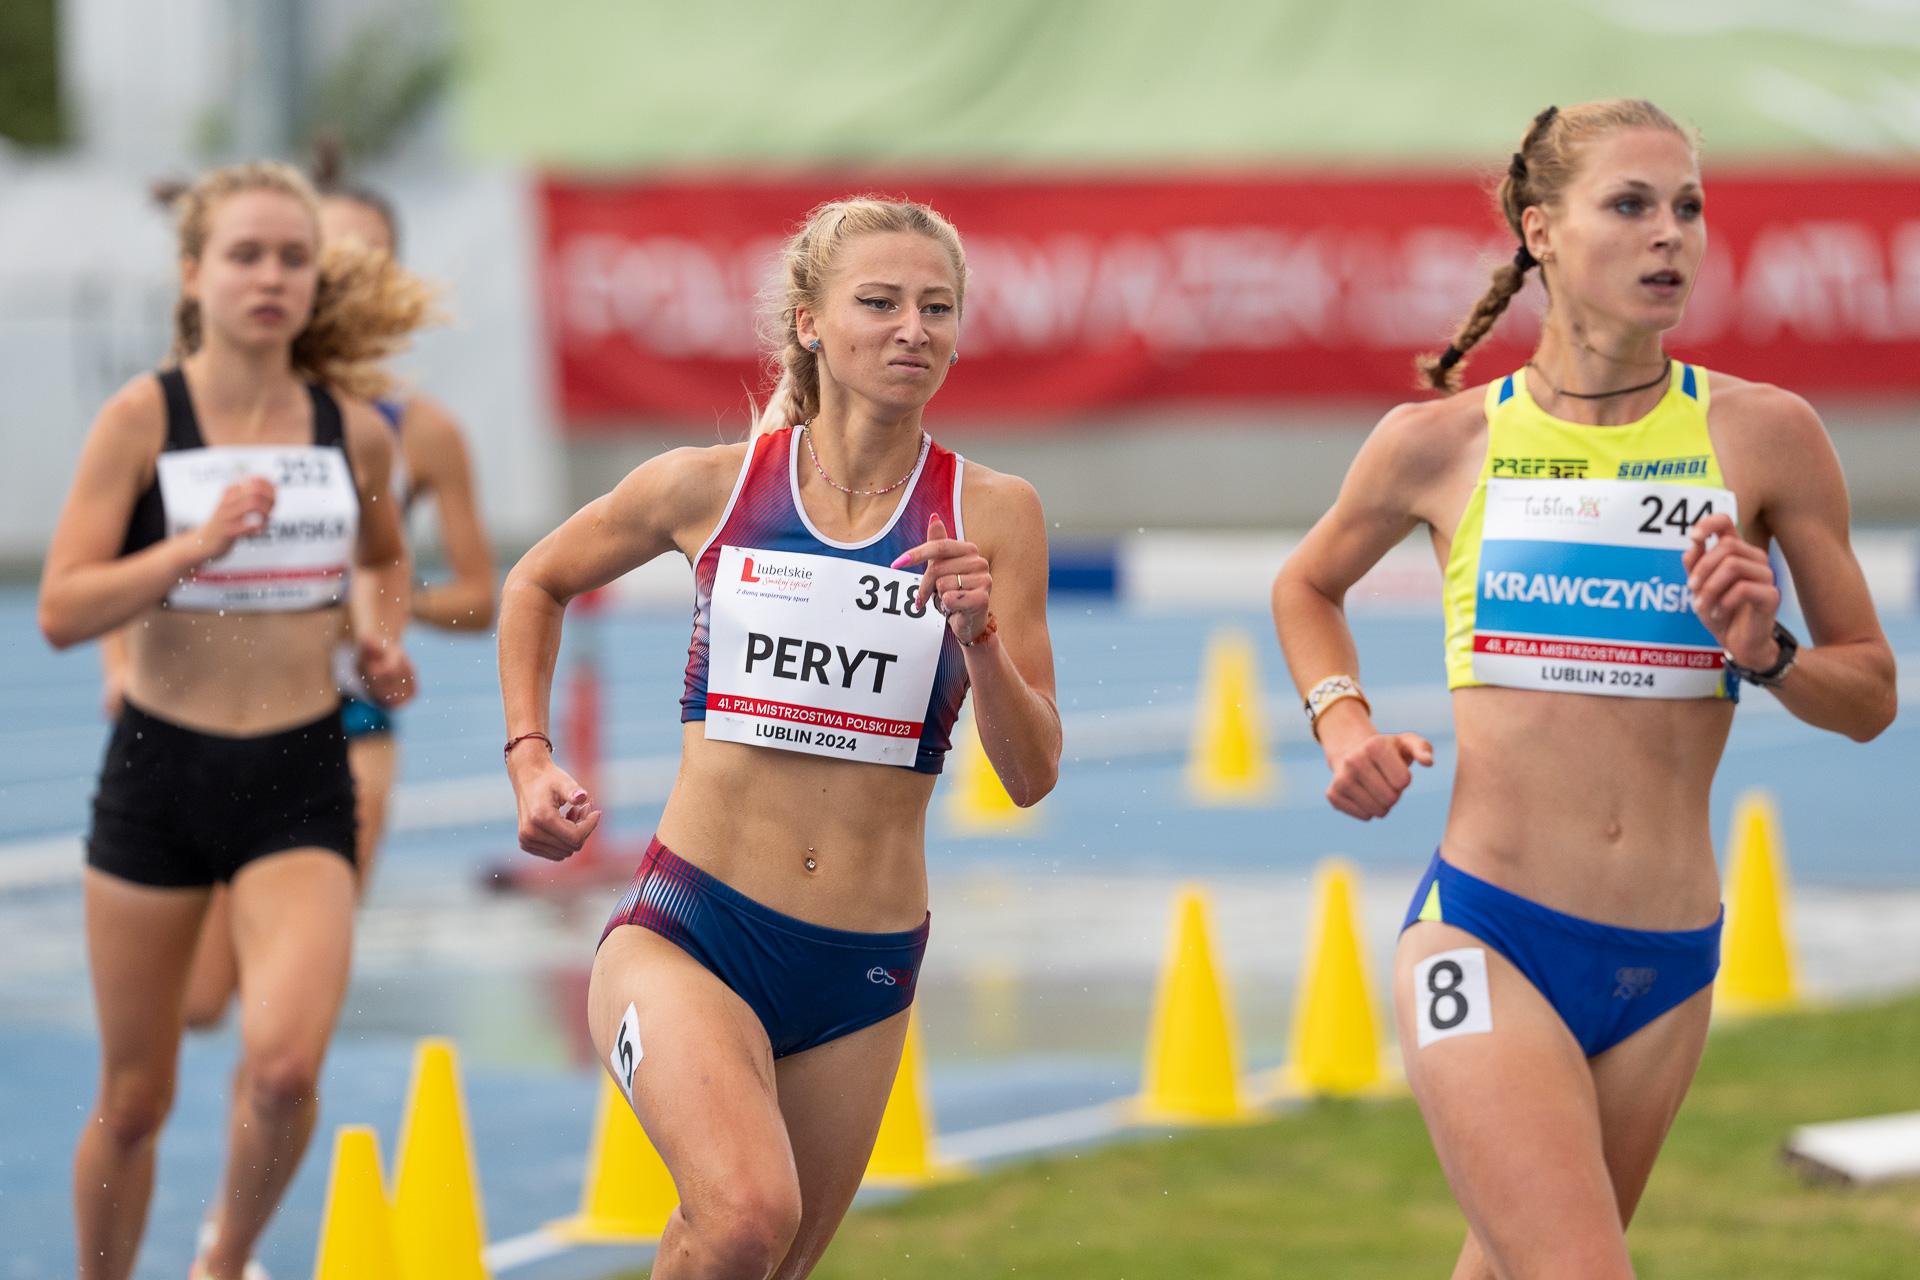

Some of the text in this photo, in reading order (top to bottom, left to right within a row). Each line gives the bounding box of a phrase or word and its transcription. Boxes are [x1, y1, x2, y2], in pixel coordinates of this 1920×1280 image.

[855, 574, 927, 619] 318
[1483, 571, 1699, 615] KRAWCZYŃSK
[744, 632, 898, 694] PERYT
[1485, 638, 1714, 668] 41. PZLA MISTRZOSTWA POLSKI U23
[1541, 665, 1655, 687] LUBLIN 2024
[717, 697, 912, 736] 41. PZLA MISTRZOSTWA POLSKI U23
[756, 723, 857, 752] LUBLIN 2024
[1427, 960, 1469, 1031] 8
[617, 1020, 634, 1090] 5
